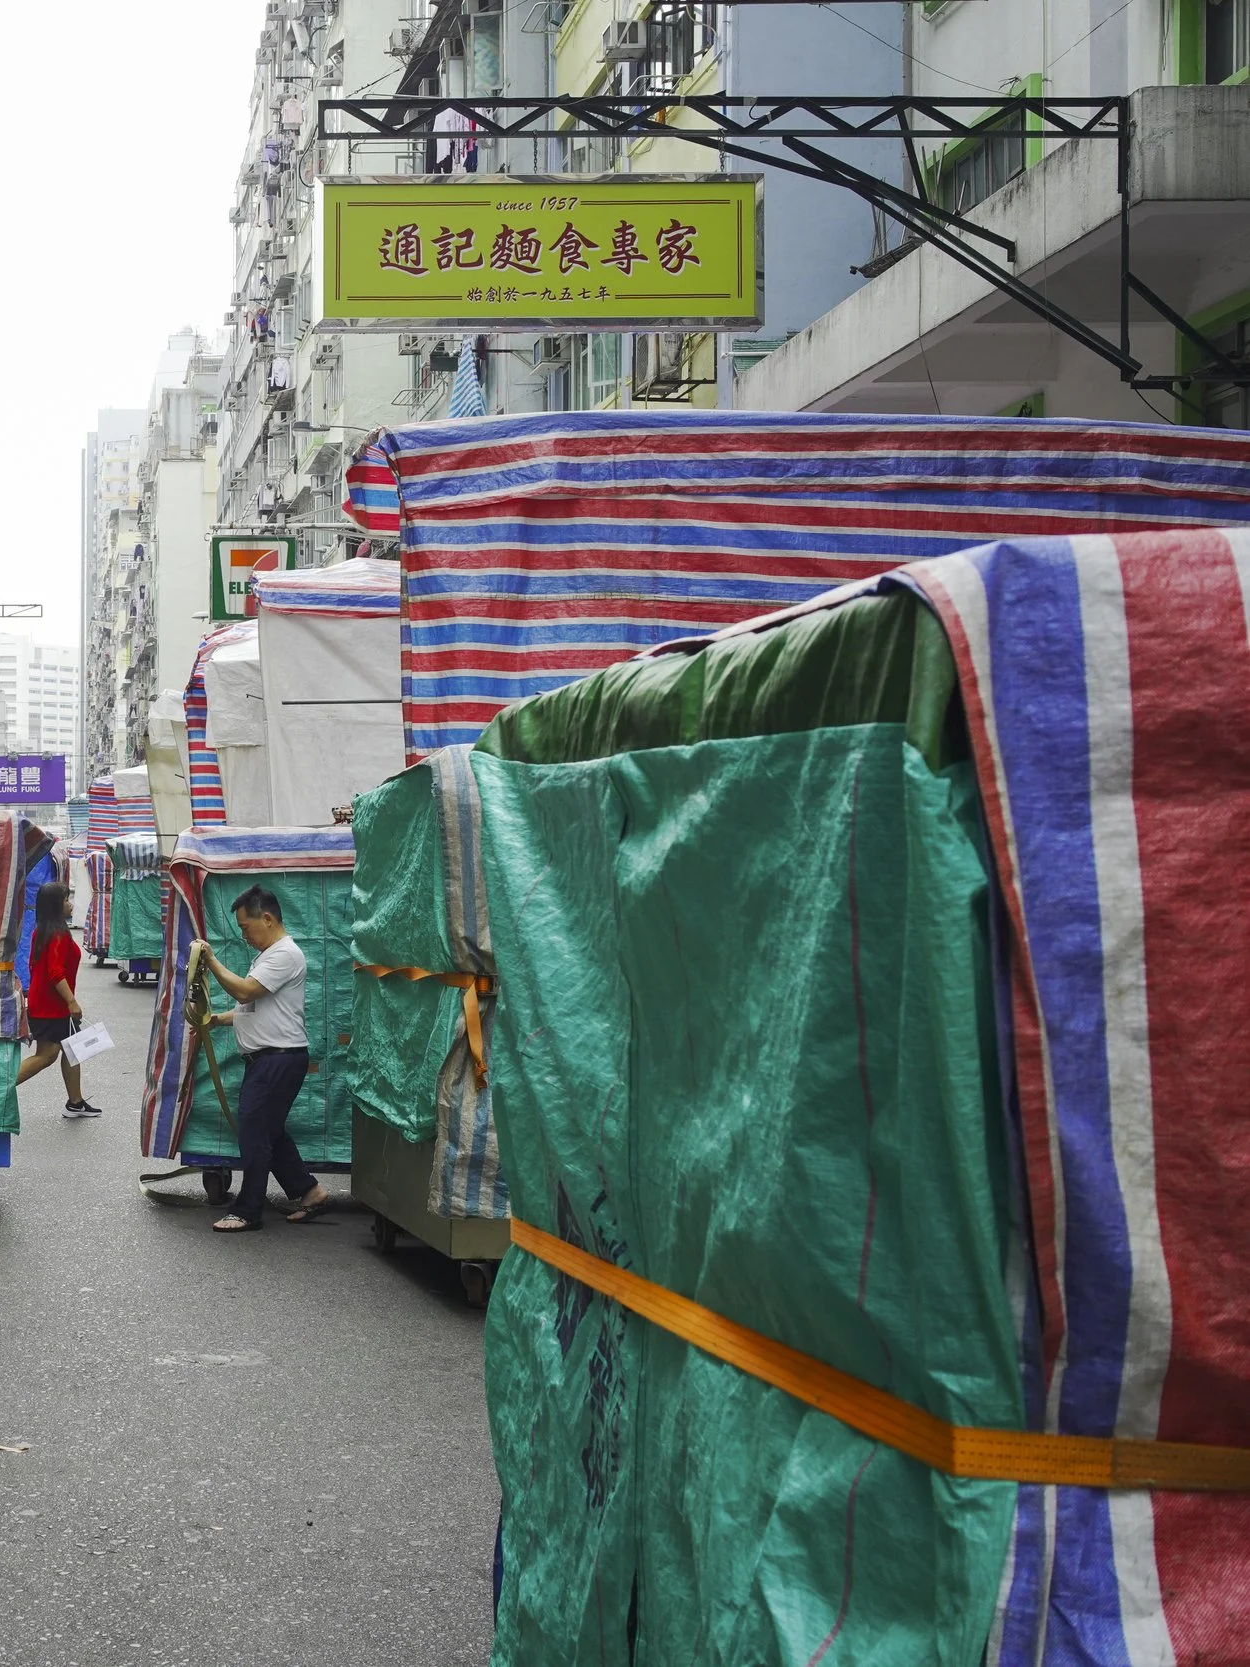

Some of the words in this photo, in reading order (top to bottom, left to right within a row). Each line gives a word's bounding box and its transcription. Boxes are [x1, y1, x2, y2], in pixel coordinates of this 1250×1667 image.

[496, 201, 533, 211] since
[540, 196, 579, 211] 1957
[378, 218, 703, 276] 通記麵食專家
[466, 285, 612, 303] 始創於一九五七年
